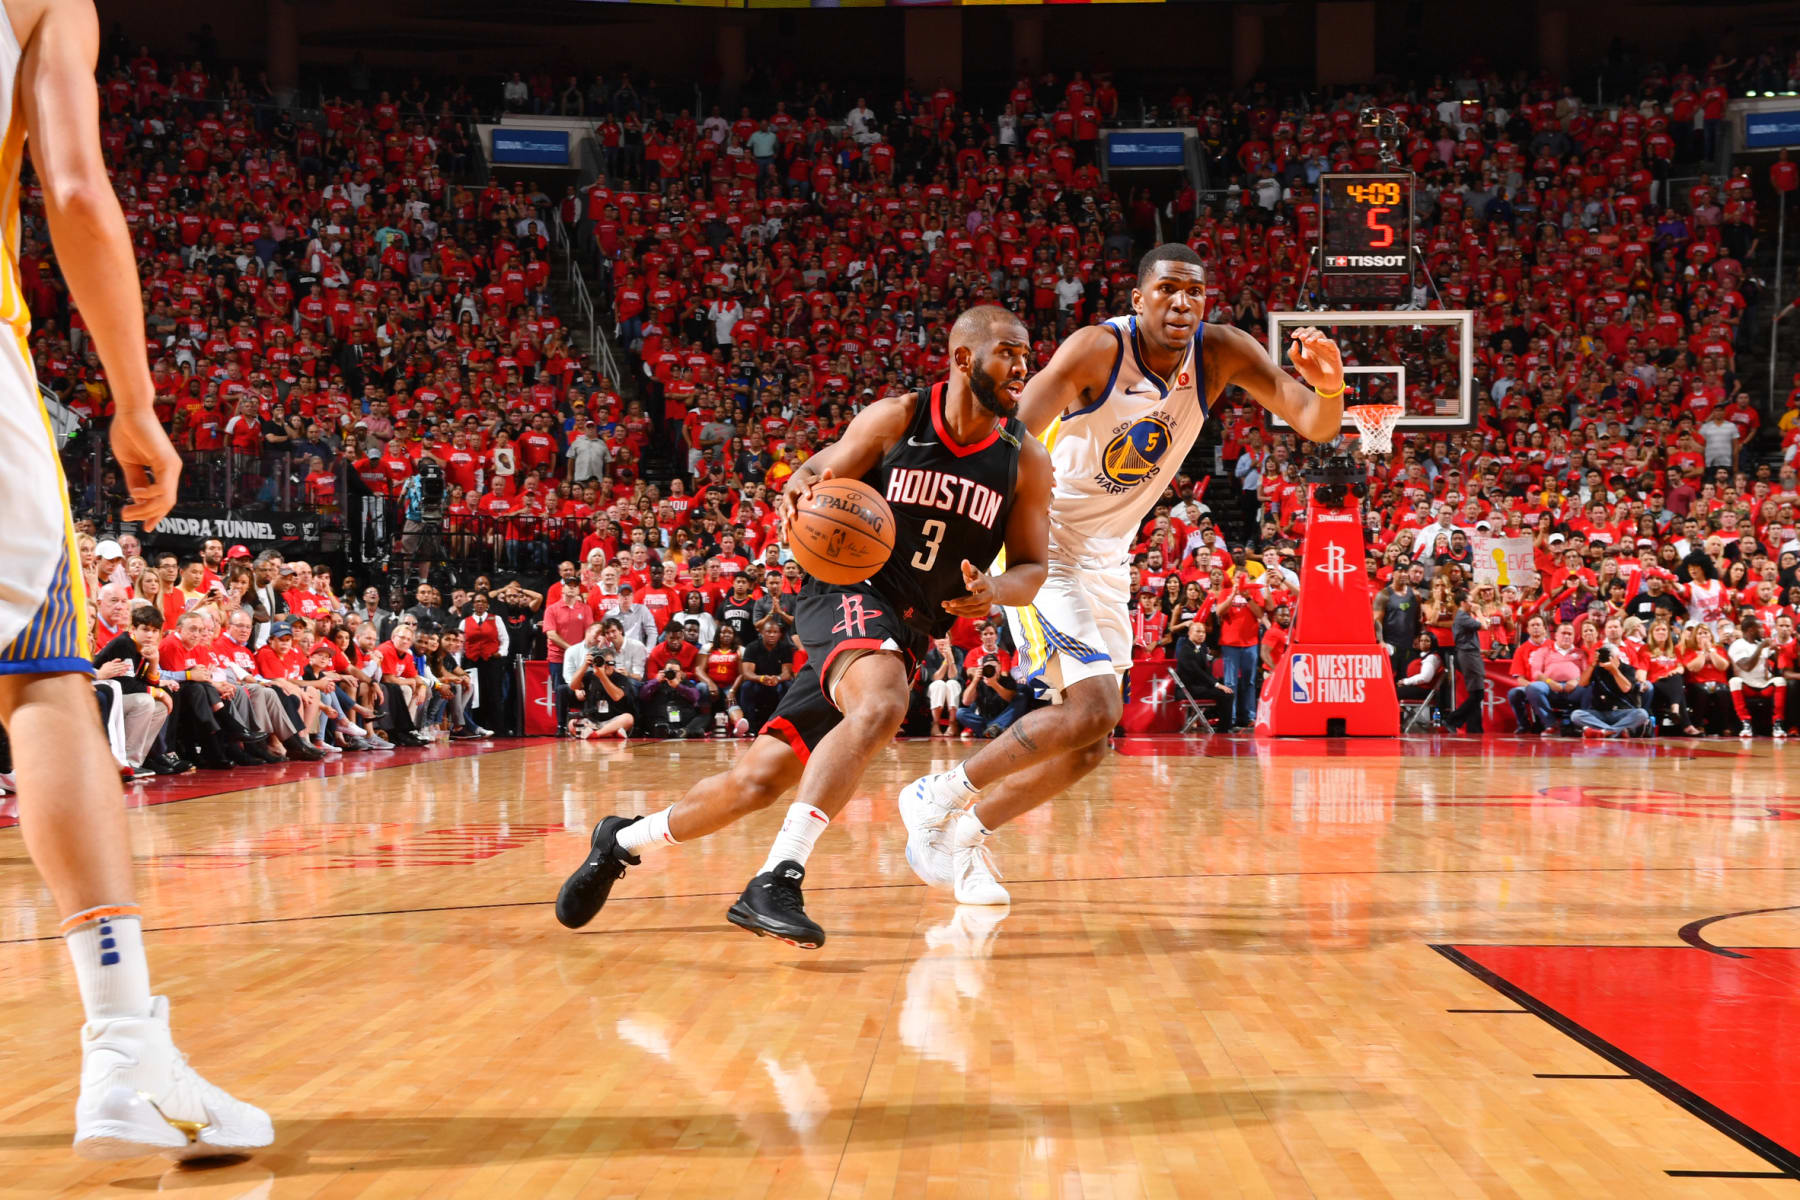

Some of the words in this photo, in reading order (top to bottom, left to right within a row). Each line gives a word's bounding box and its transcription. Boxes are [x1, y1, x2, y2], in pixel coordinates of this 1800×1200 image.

[1346, 182, 1400, 205] 4:09
[1367, 207, 1394, 248] 5
[1347, 256, 1406, 267] TISSOT
[1151, 410, 1178, 430] STAE
[1144, 432, 1161, 452] 5
[886, 467, 1003, 530] HOUSTON
[811, 494, 884, 535] SPALDING
[156, 517, 213, 537] UNDRA
[214, 519, 276, 539] TUNNEL
[910, 518, 947, 572] 3
[1316, 654, 1383, 679] WESTERN
[1317, 678, 1366, 703] FINALS
